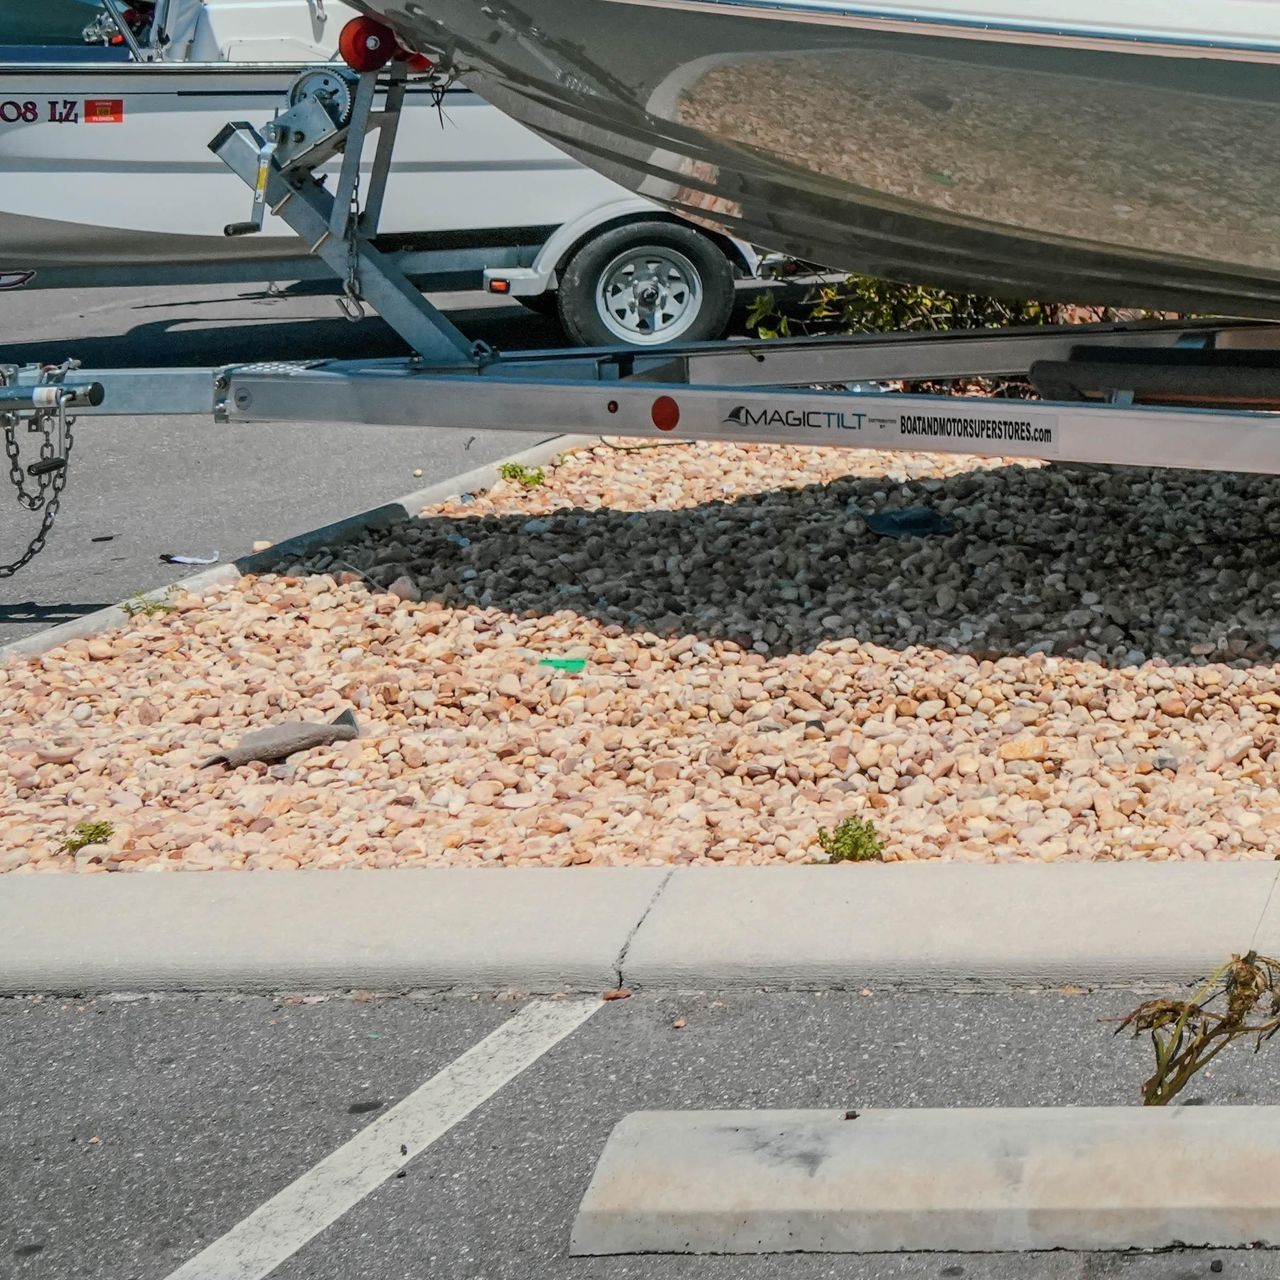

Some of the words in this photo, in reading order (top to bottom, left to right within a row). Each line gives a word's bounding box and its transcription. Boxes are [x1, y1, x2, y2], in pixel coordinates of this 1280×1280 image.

[48, 100, 78, 123] LZ
[745, 408, 866, 430] MAGICTILT
[901, 415, 1051, 443] BOATANDMOTORSUPERSTORES.com
